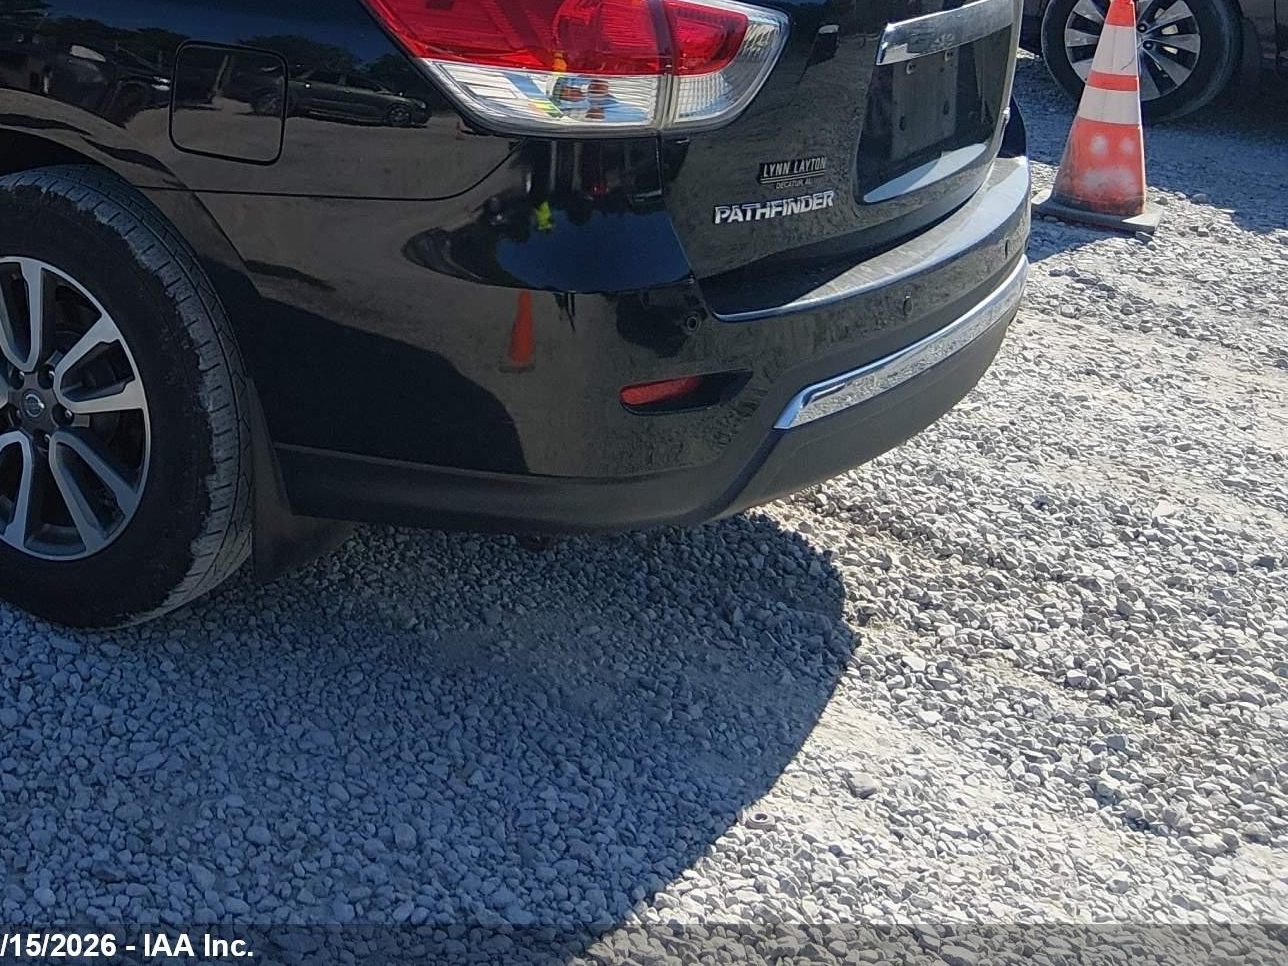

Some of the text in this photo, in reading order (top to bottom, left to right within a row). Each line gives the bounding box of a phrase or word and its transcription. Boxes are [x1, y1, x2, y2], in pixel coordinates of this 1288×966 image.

[763, 156, 827, 177] LYNN LAYTON
[714, 190, 835, 225] PATHFINDER
